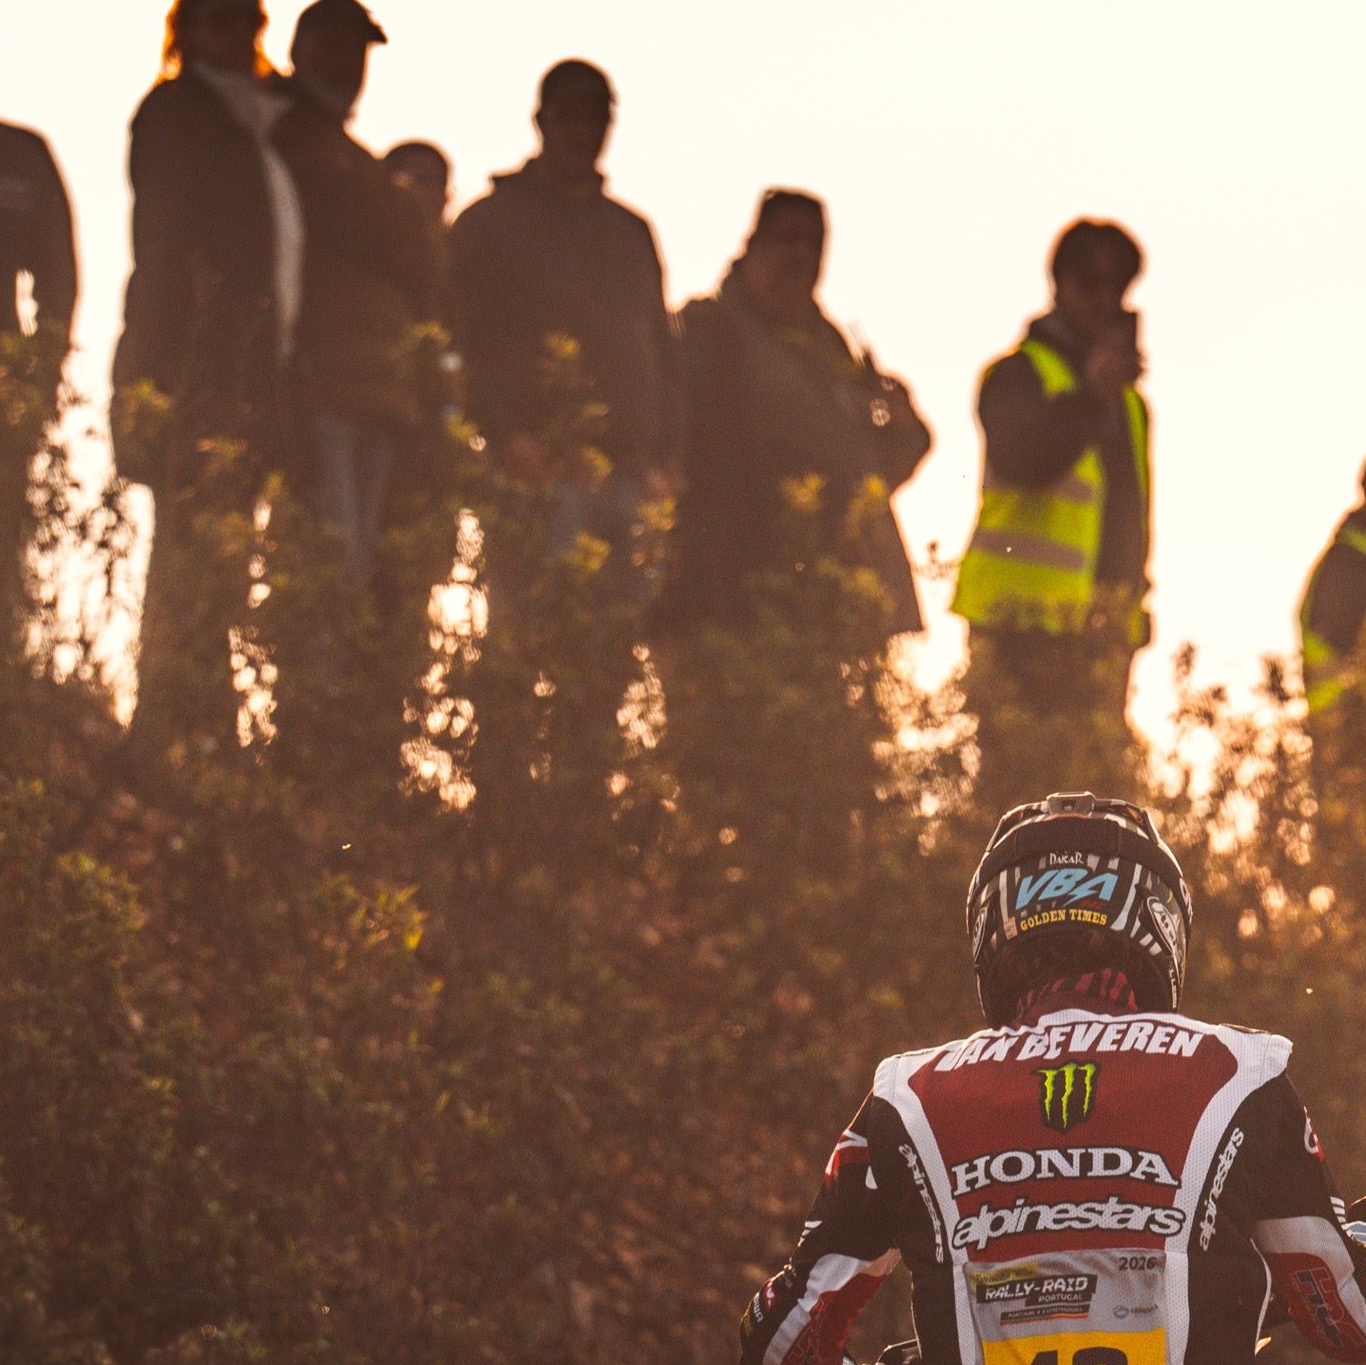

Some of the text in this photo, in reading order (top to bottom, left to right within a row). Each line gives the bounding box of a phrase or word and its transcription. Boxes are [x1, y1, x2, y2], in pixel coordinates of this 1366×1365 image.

[1016, 868, 1119, 911] VBA
[1020, 909, 1108, 932] GOLDEN TIMES
[1016, 1021, 1205, 1061] BEVEREN
[951, 1147, 1179, 1196] HONDA
[953, 1196, 1185, 1250] alpinestars
[985, 1276, 1089, 1300] RALLY-RAID
[1038, 1293, 1083, 1303] PORTUGAL
